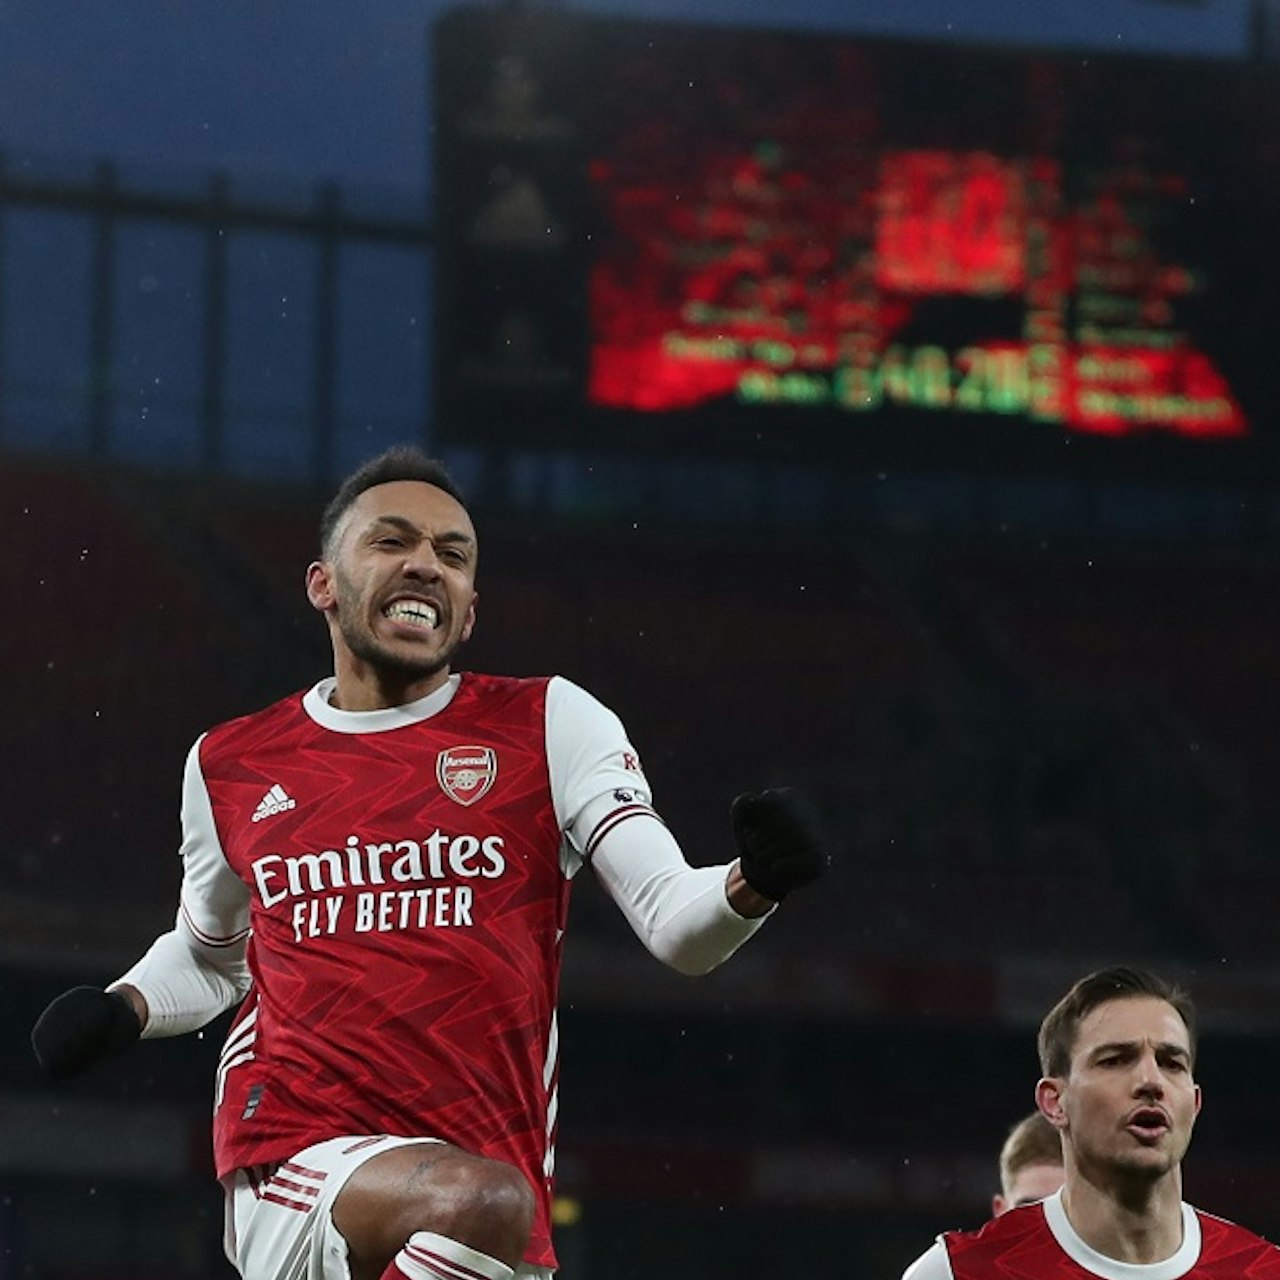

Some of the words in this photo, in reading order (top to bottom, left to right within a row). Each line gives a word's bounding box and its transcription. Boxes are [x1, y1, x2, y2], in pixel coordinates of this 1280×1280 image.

[251, 799, 296, 823] adidas
[251, 829, 505, 909] Emirates
[292, 895, 344, 943] FLY
[355, 886, 473, 933] BETTER
